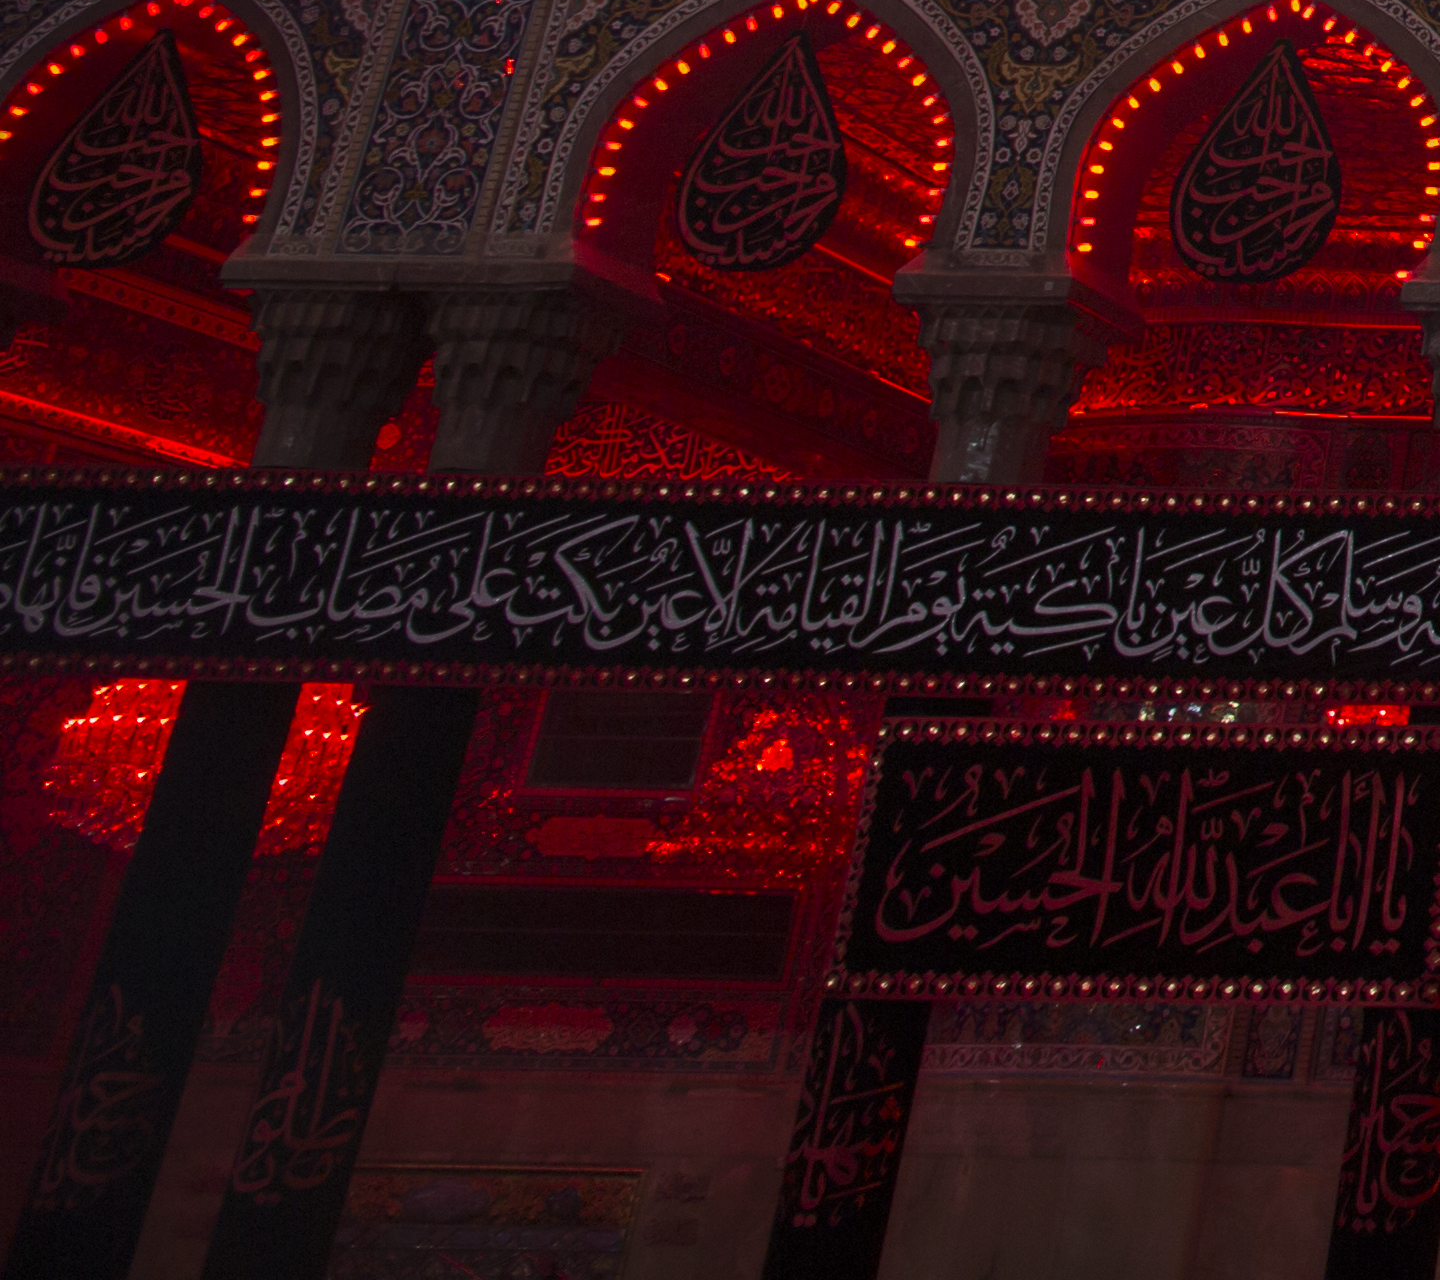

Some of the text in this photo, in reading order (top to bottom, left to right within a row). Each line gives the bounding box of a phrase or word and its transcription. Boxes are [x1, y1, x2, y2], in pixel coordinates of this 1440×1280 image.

[55, 506, 260, 638] الحسين
[246, 506, 430, 640] مصاب
[738, 518, 901, 652] القيامة
[951, 527, 1145, 654] باكية
[1290, 530, 1421, 654] وسلم
[875, 766, 1125, 950] الحسين
